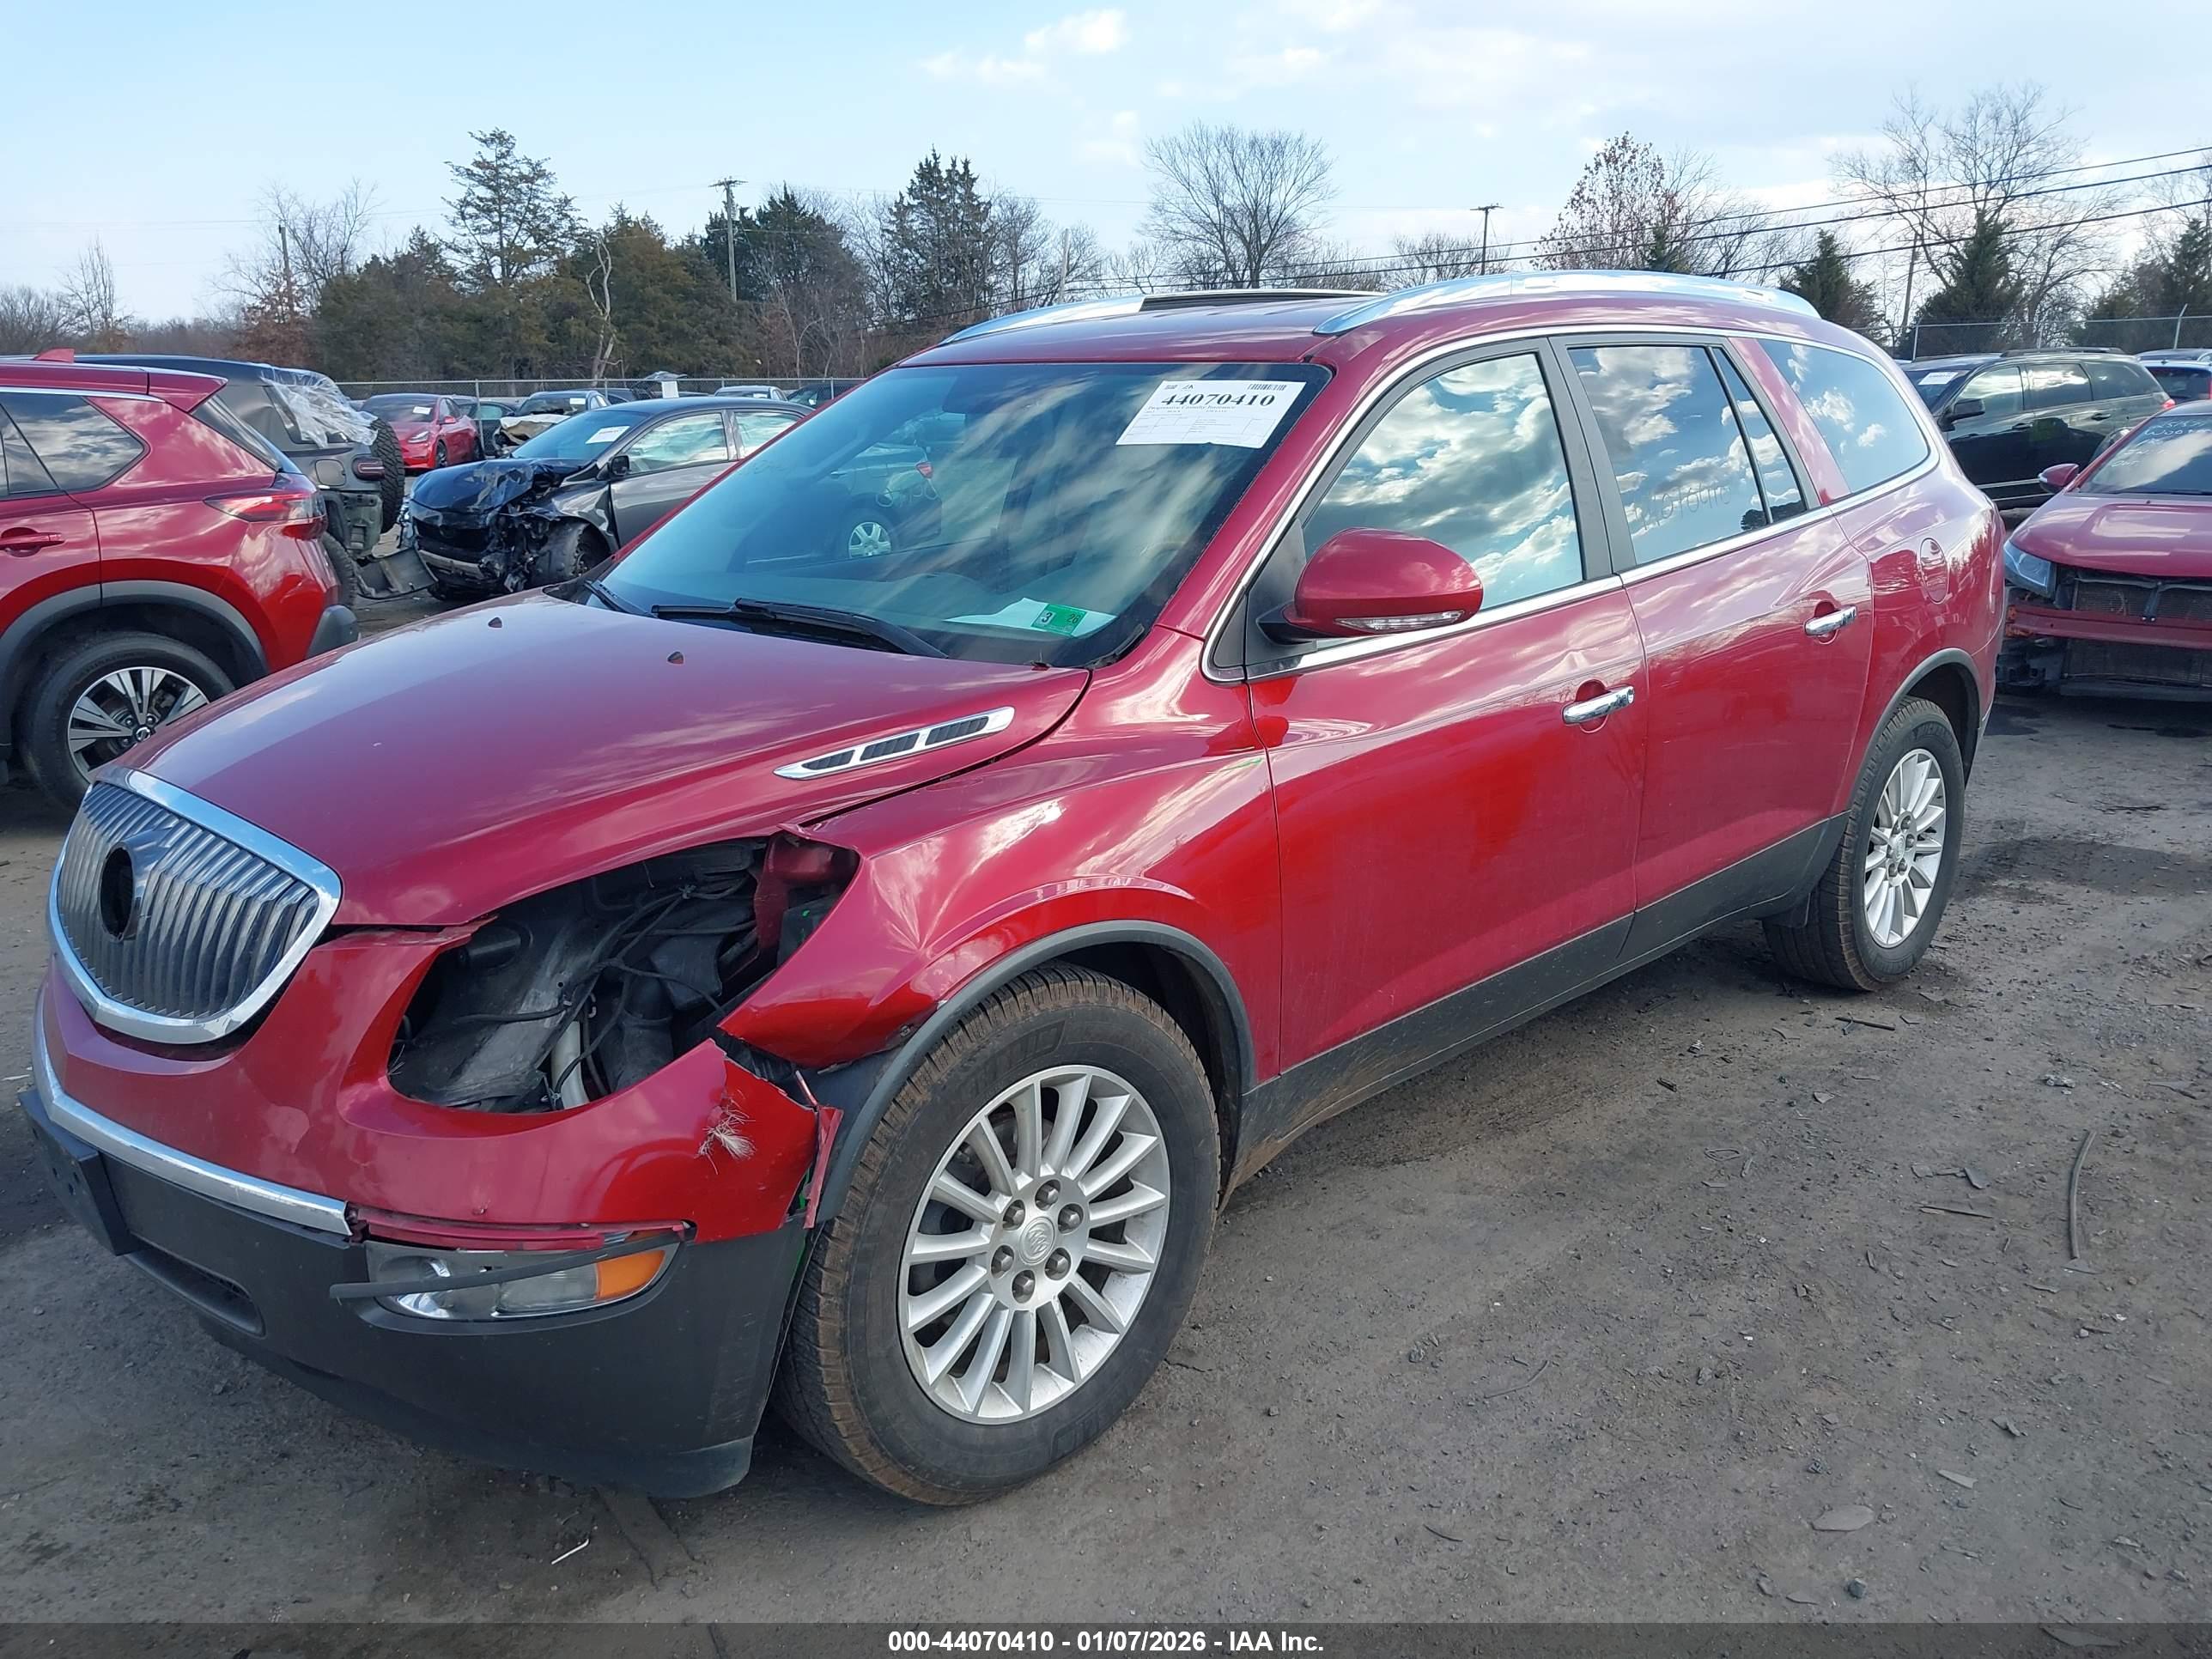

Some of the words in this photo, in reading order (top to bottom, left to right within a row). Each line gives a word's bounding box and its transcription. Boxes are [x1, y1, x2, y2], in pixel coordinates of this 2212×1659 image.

[1161, 393, 1275, 406] 44070410
[1042, 611, 1053, 623] 3
[1067, 613, 1081, 624] 26
